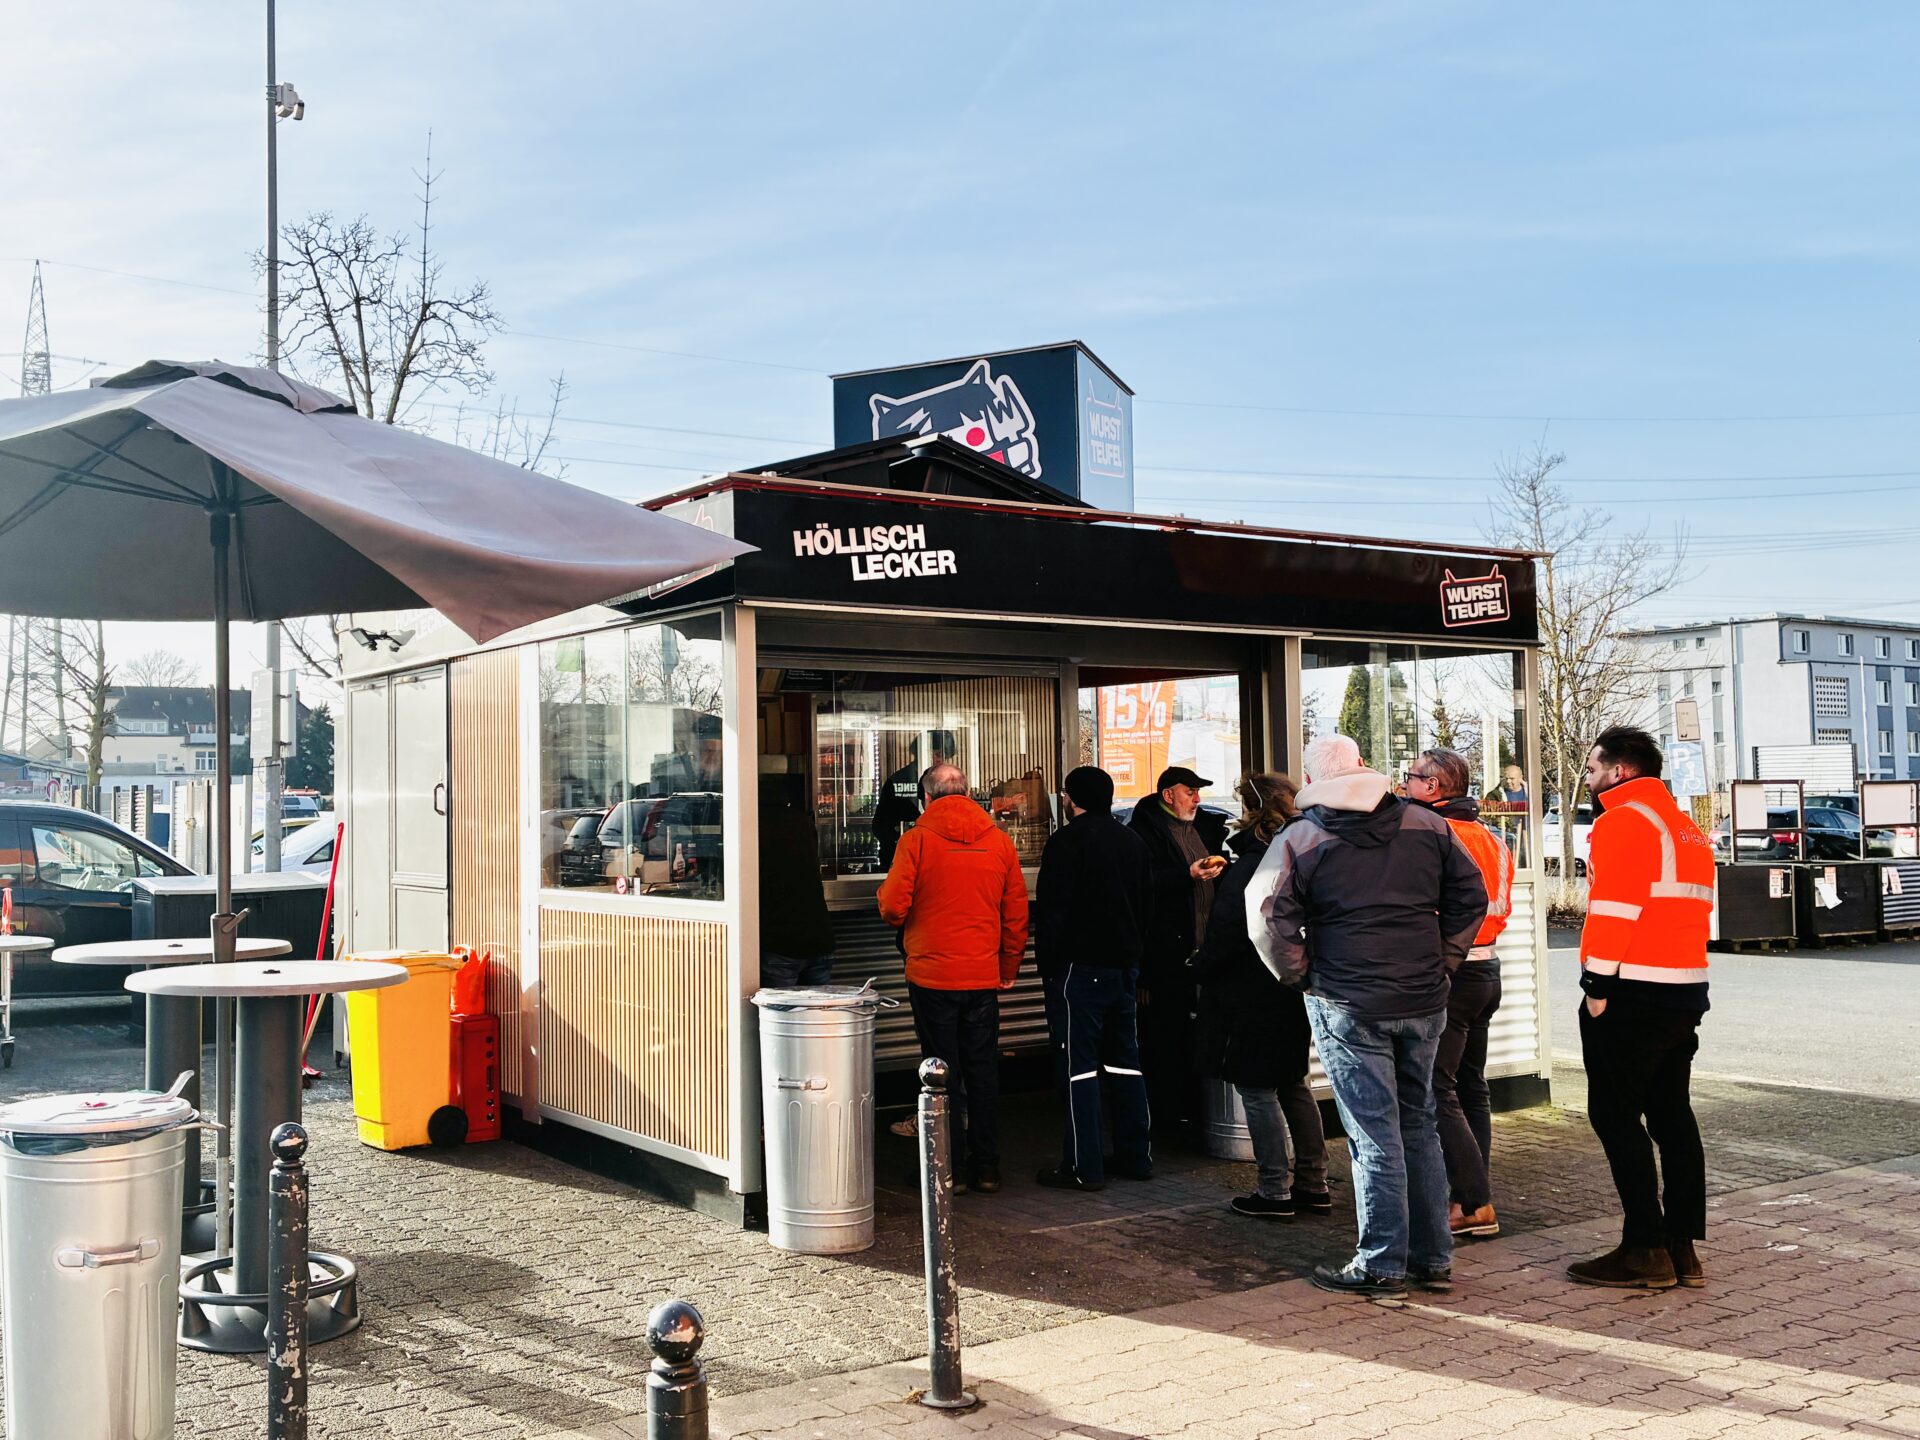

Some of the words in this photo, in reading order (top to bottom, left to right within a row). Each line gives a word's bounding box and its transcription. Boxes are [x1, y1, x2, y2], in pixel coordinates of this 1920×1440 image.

[1089, 411, 1121, 440] WURST
[1090, 440, 1123, 467] TEUFEL
[793, 523, 926, 556] HÖLLISCH
[851, 550, 957, 581] LECKER
[1446, 583, 1502, 603] WURST
[1448, 600, 1505, 620] TEUFEL
[1102, 682, 1167, 729] 15%
[1673, 748, 1690, 770] P
